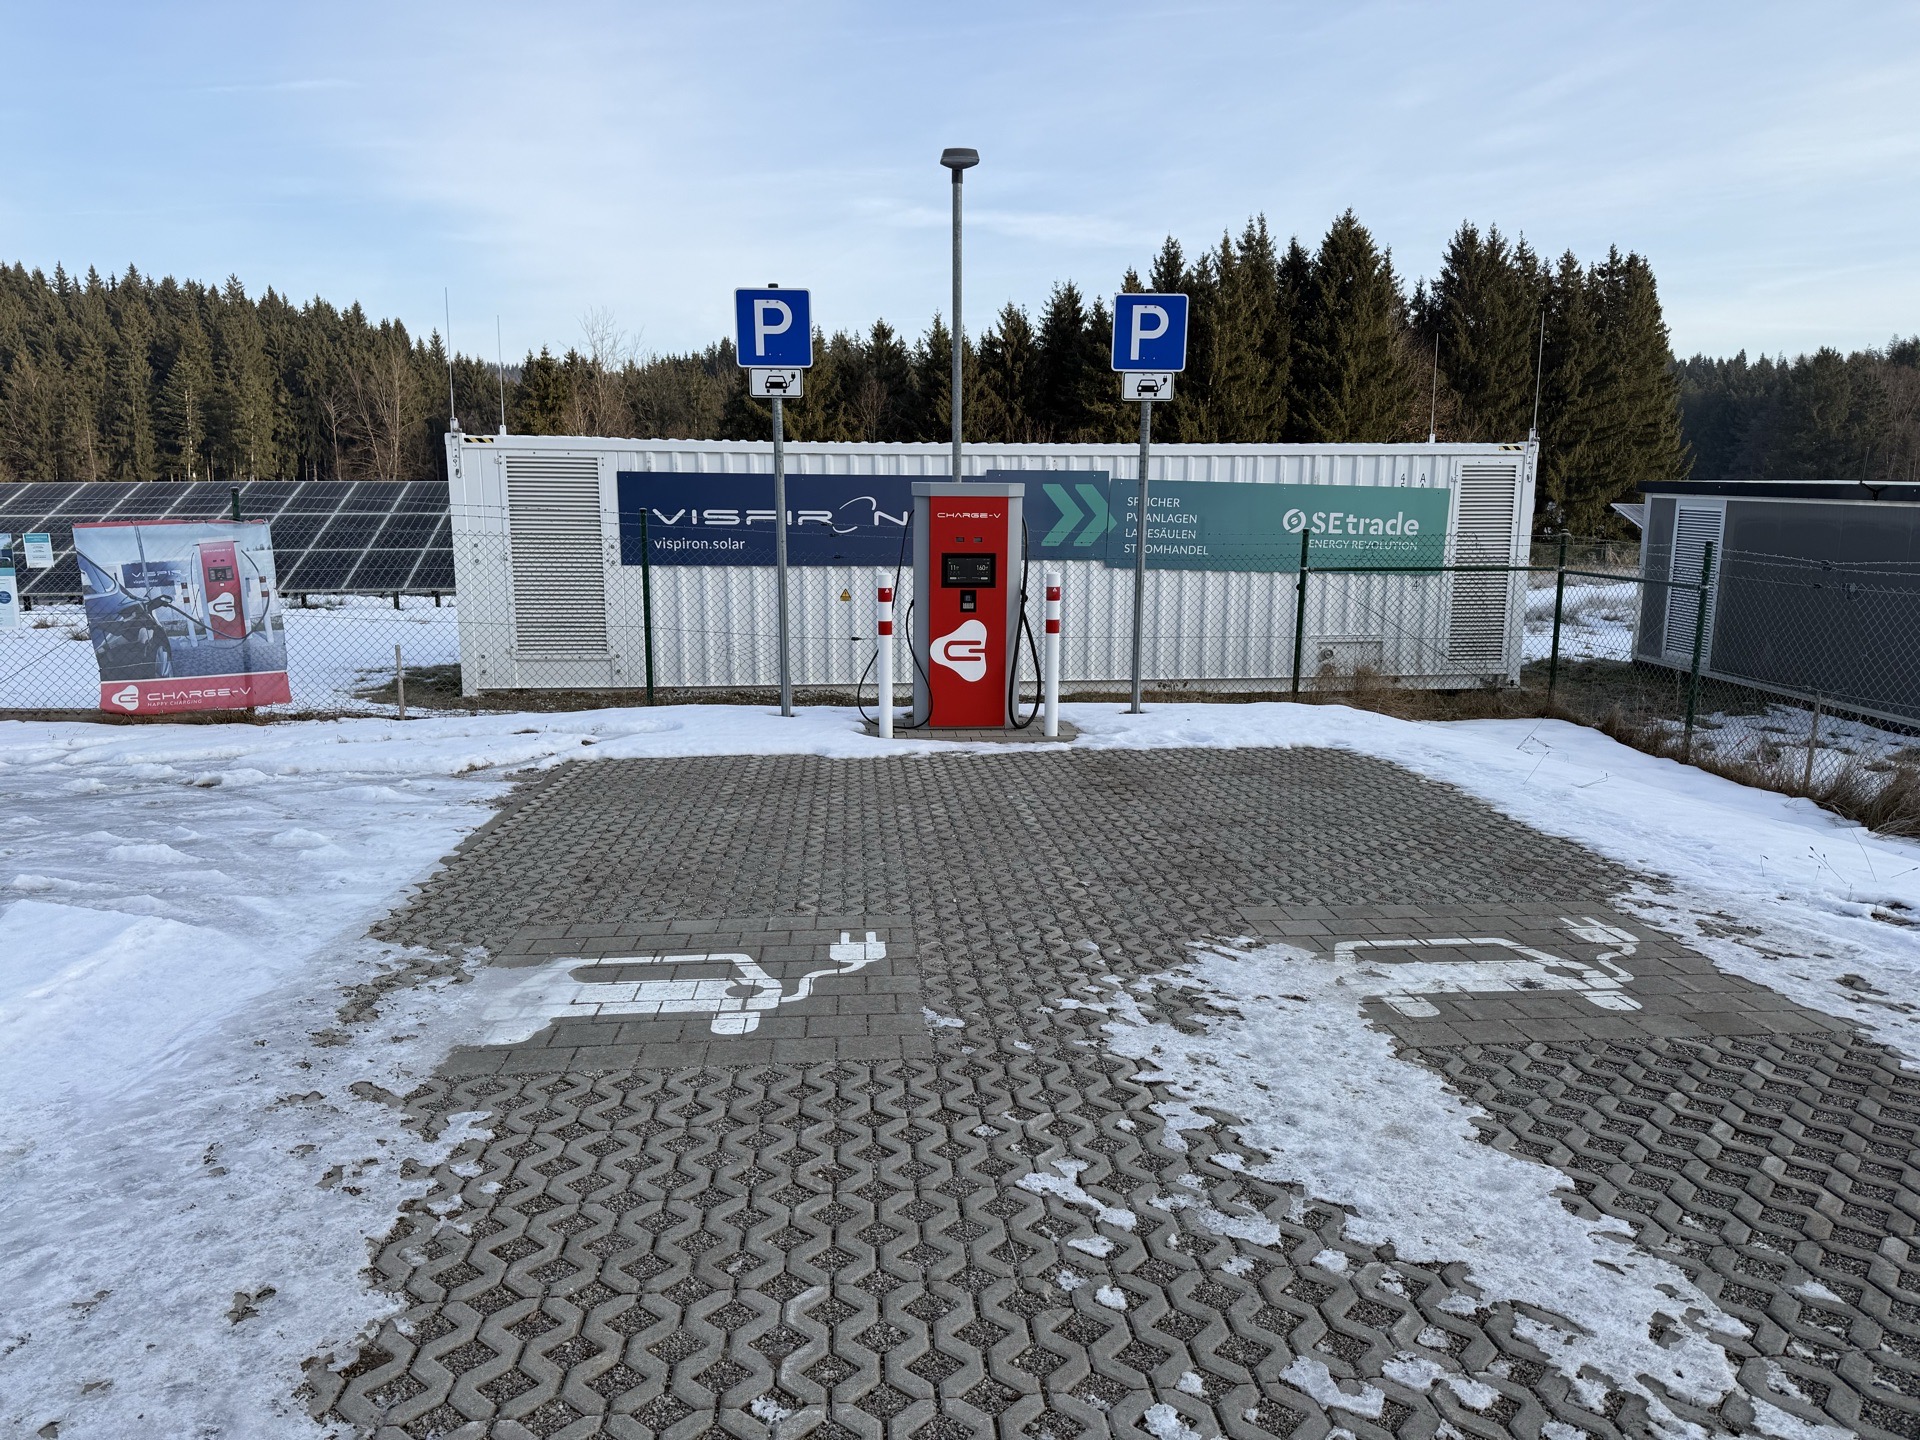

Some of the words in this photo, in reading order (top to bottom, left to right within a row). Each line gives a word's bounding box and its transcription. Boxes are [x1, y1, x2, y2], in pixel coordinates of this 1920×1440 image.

[754, 299, 793, 356] P
[1130, 304, 1169, 360] P
[1127, 496, 1180, 508] SPICHER
[1126, 512, 1198, 524] PVANLAGEN
[1125, 527, 1196, 539] LAESÄULEN
[654, 536, 746, 551] vispiron.solar
[1124, 543, 1209, 555] STOMHANDEL
[1309, 539, 1350, 549] ENERGY
[1351, 540, 1418, 551] REVOLUTION
[147, 687, 251, 701] CHARGE-V
